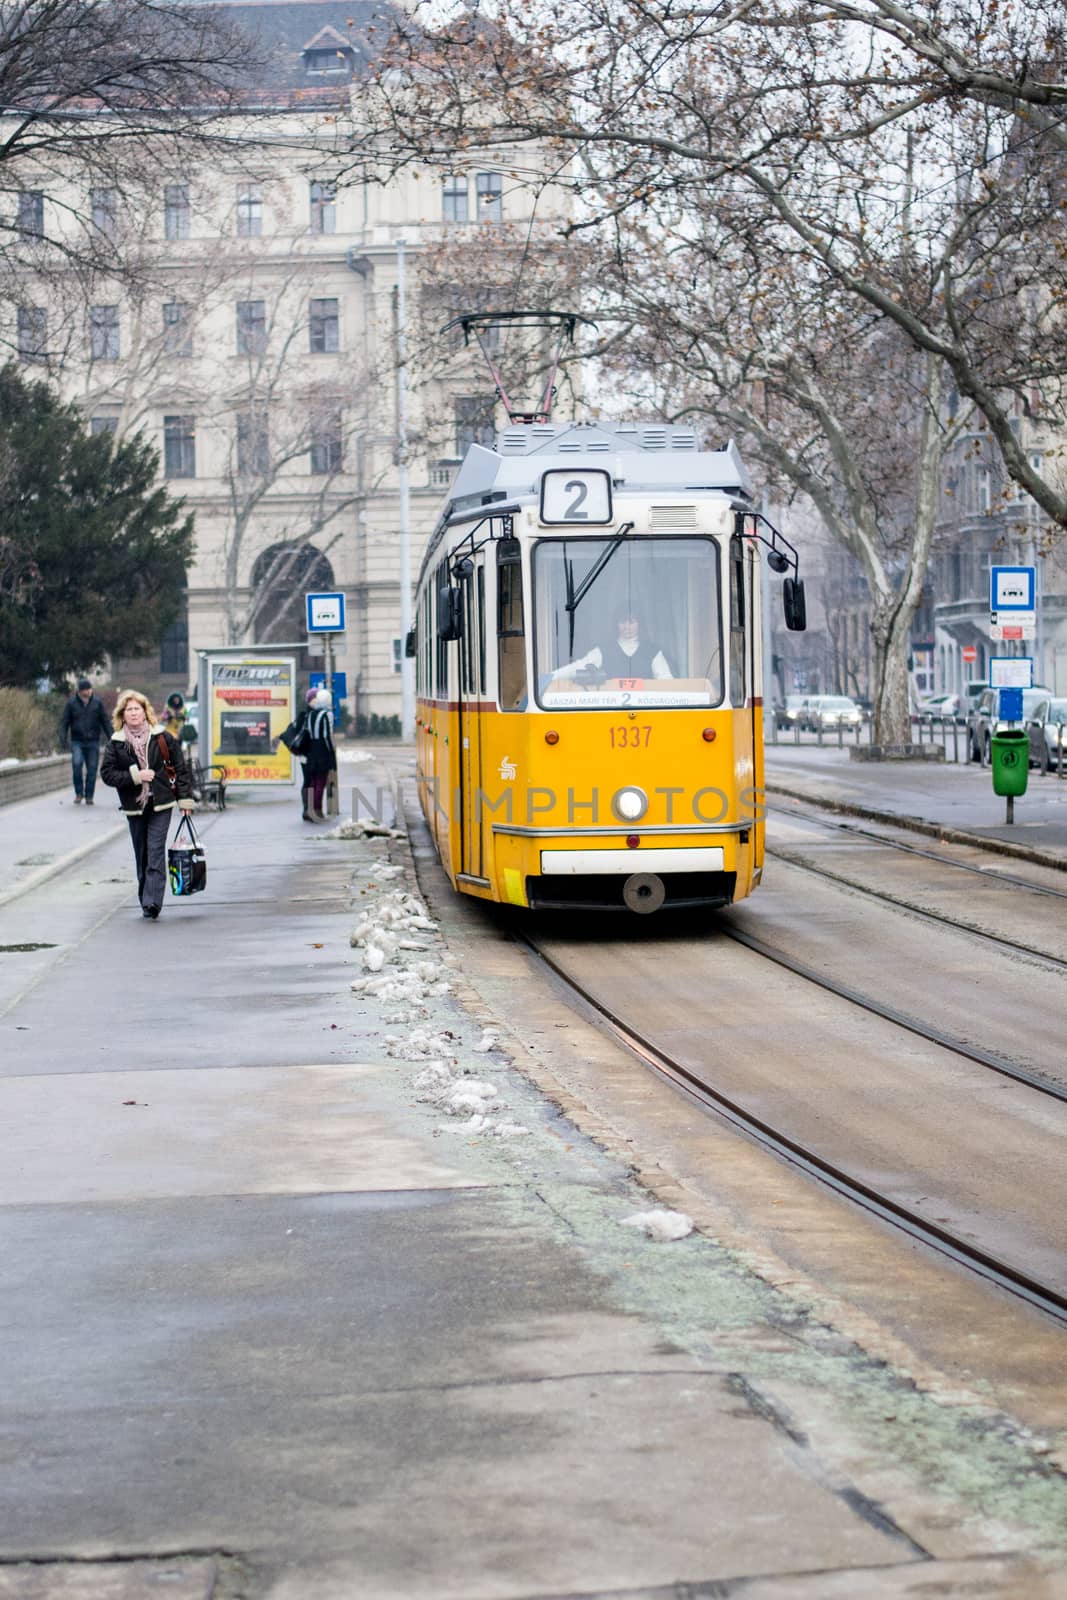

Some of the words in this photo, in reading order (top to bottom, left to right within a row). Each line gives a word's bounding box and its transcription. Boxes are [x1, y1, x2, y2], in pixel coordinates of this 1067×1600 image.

[564, 480, 588, 519] 2
[621, 692, 632, 706] 2
[609, 726, 652, 749] 1337
